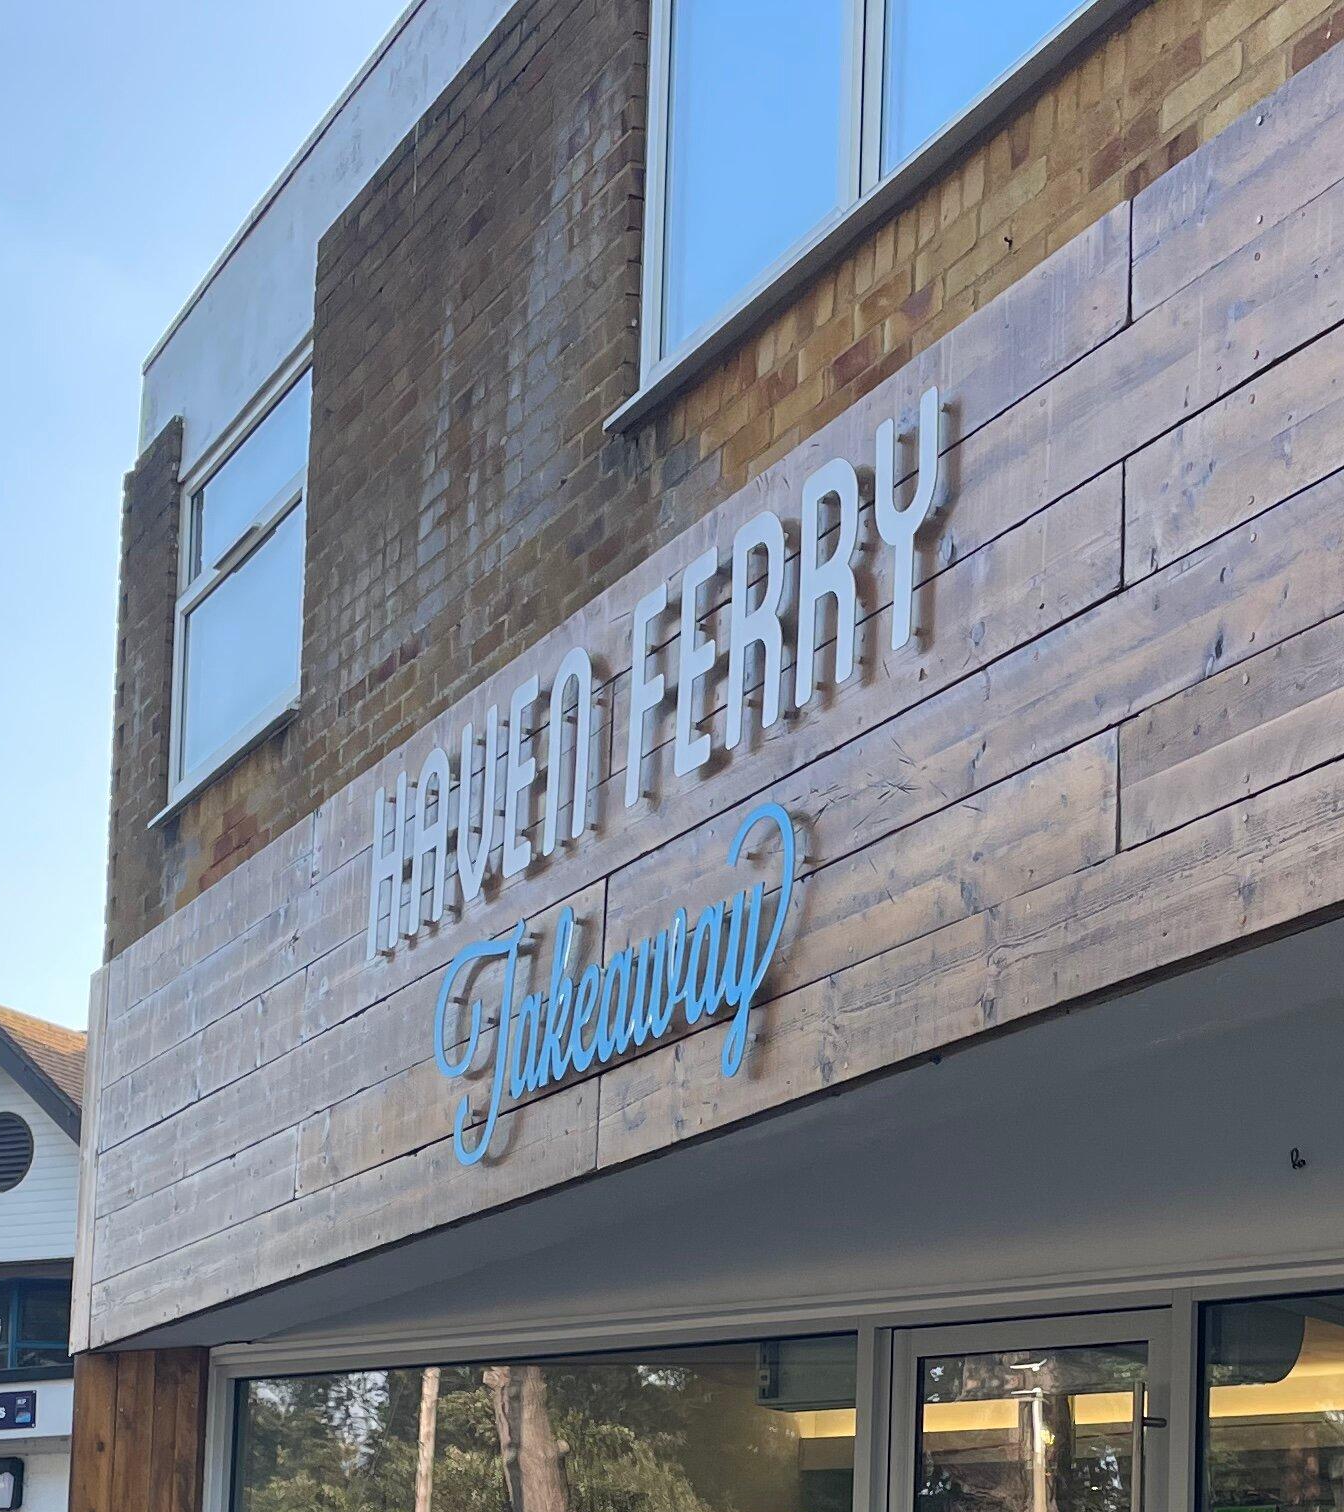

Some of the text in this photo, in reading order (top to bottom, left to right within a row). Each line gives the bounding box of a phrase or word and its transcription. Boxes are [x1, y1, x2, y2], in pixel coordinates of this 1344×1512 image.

[365, 384, 940, 962] HAVEN FERRY
[433, 802, 797, 1166] Takeaway
